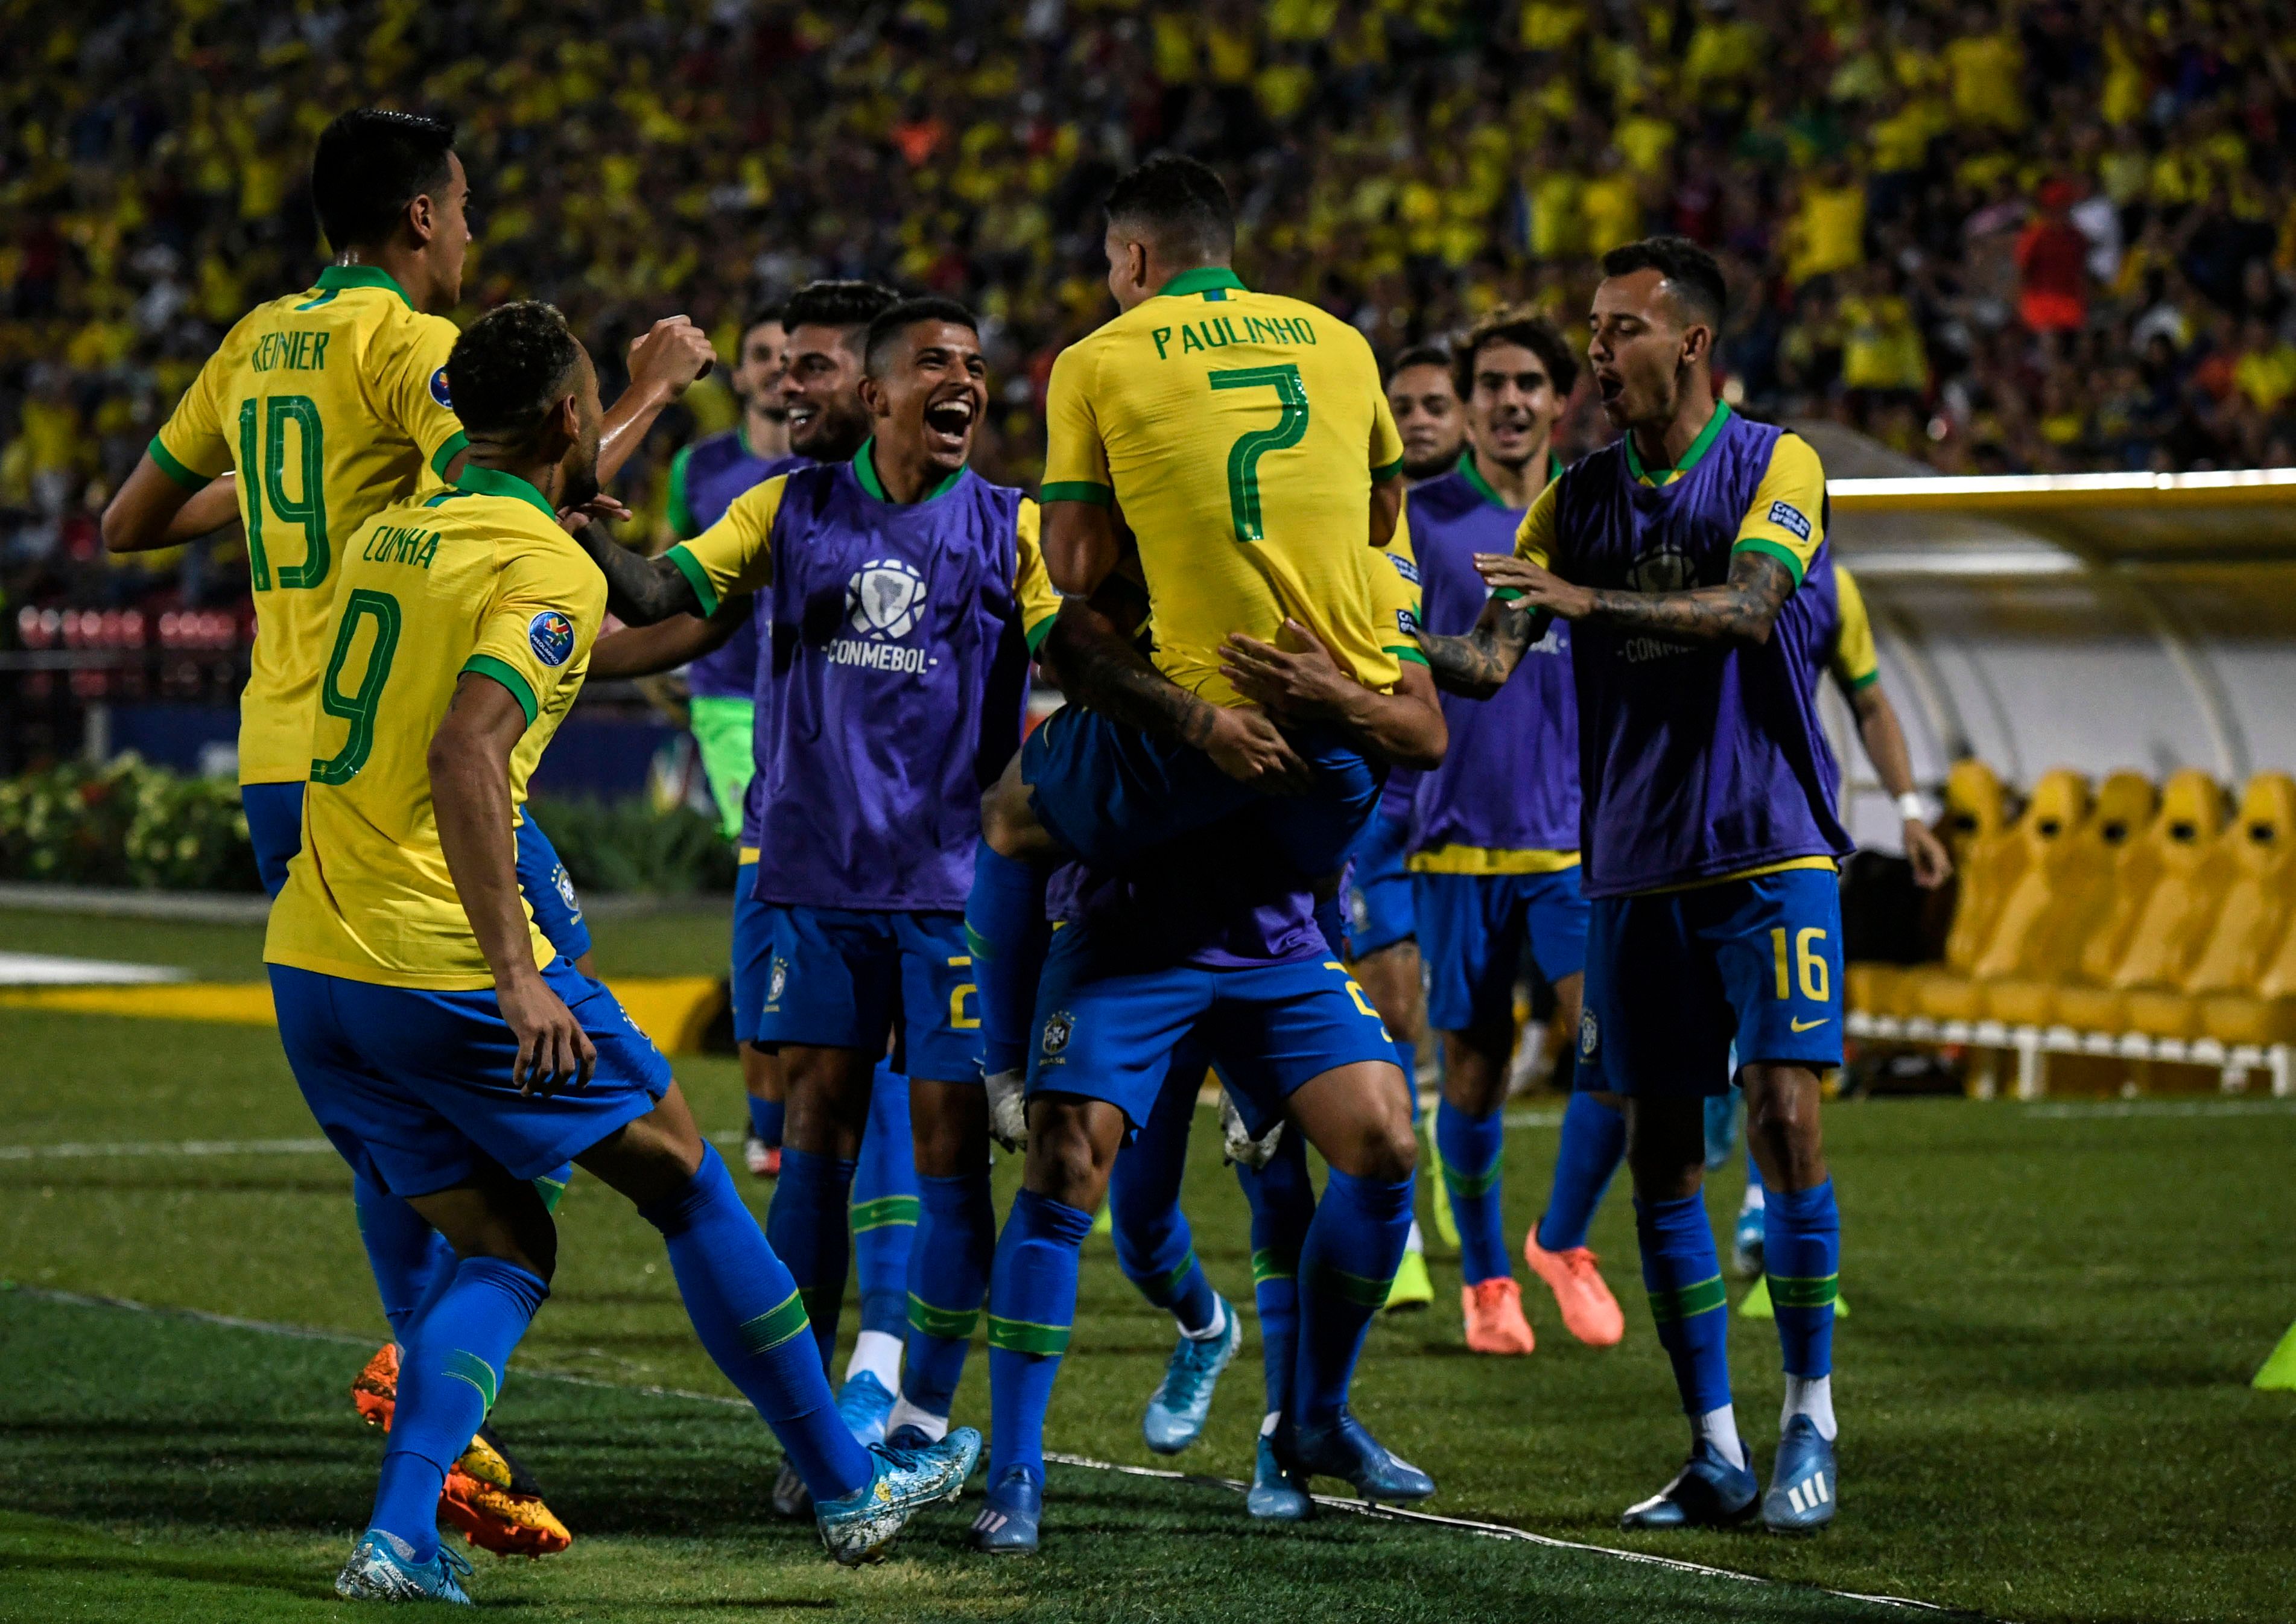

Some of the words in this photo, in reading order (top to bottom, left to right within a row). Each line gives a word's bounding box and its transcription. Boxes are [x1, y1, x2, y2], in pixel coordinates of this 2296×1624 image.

[1152, 316, 1316, 360] PAULINHO
[238, 395, 331, 591] 19
[1207, 363, 1309, 542] 7
[363, 525, 441, 569] CUNHA
[310, 588, 401, 785] 9
[1770, 927, 1829, 1002] 16
